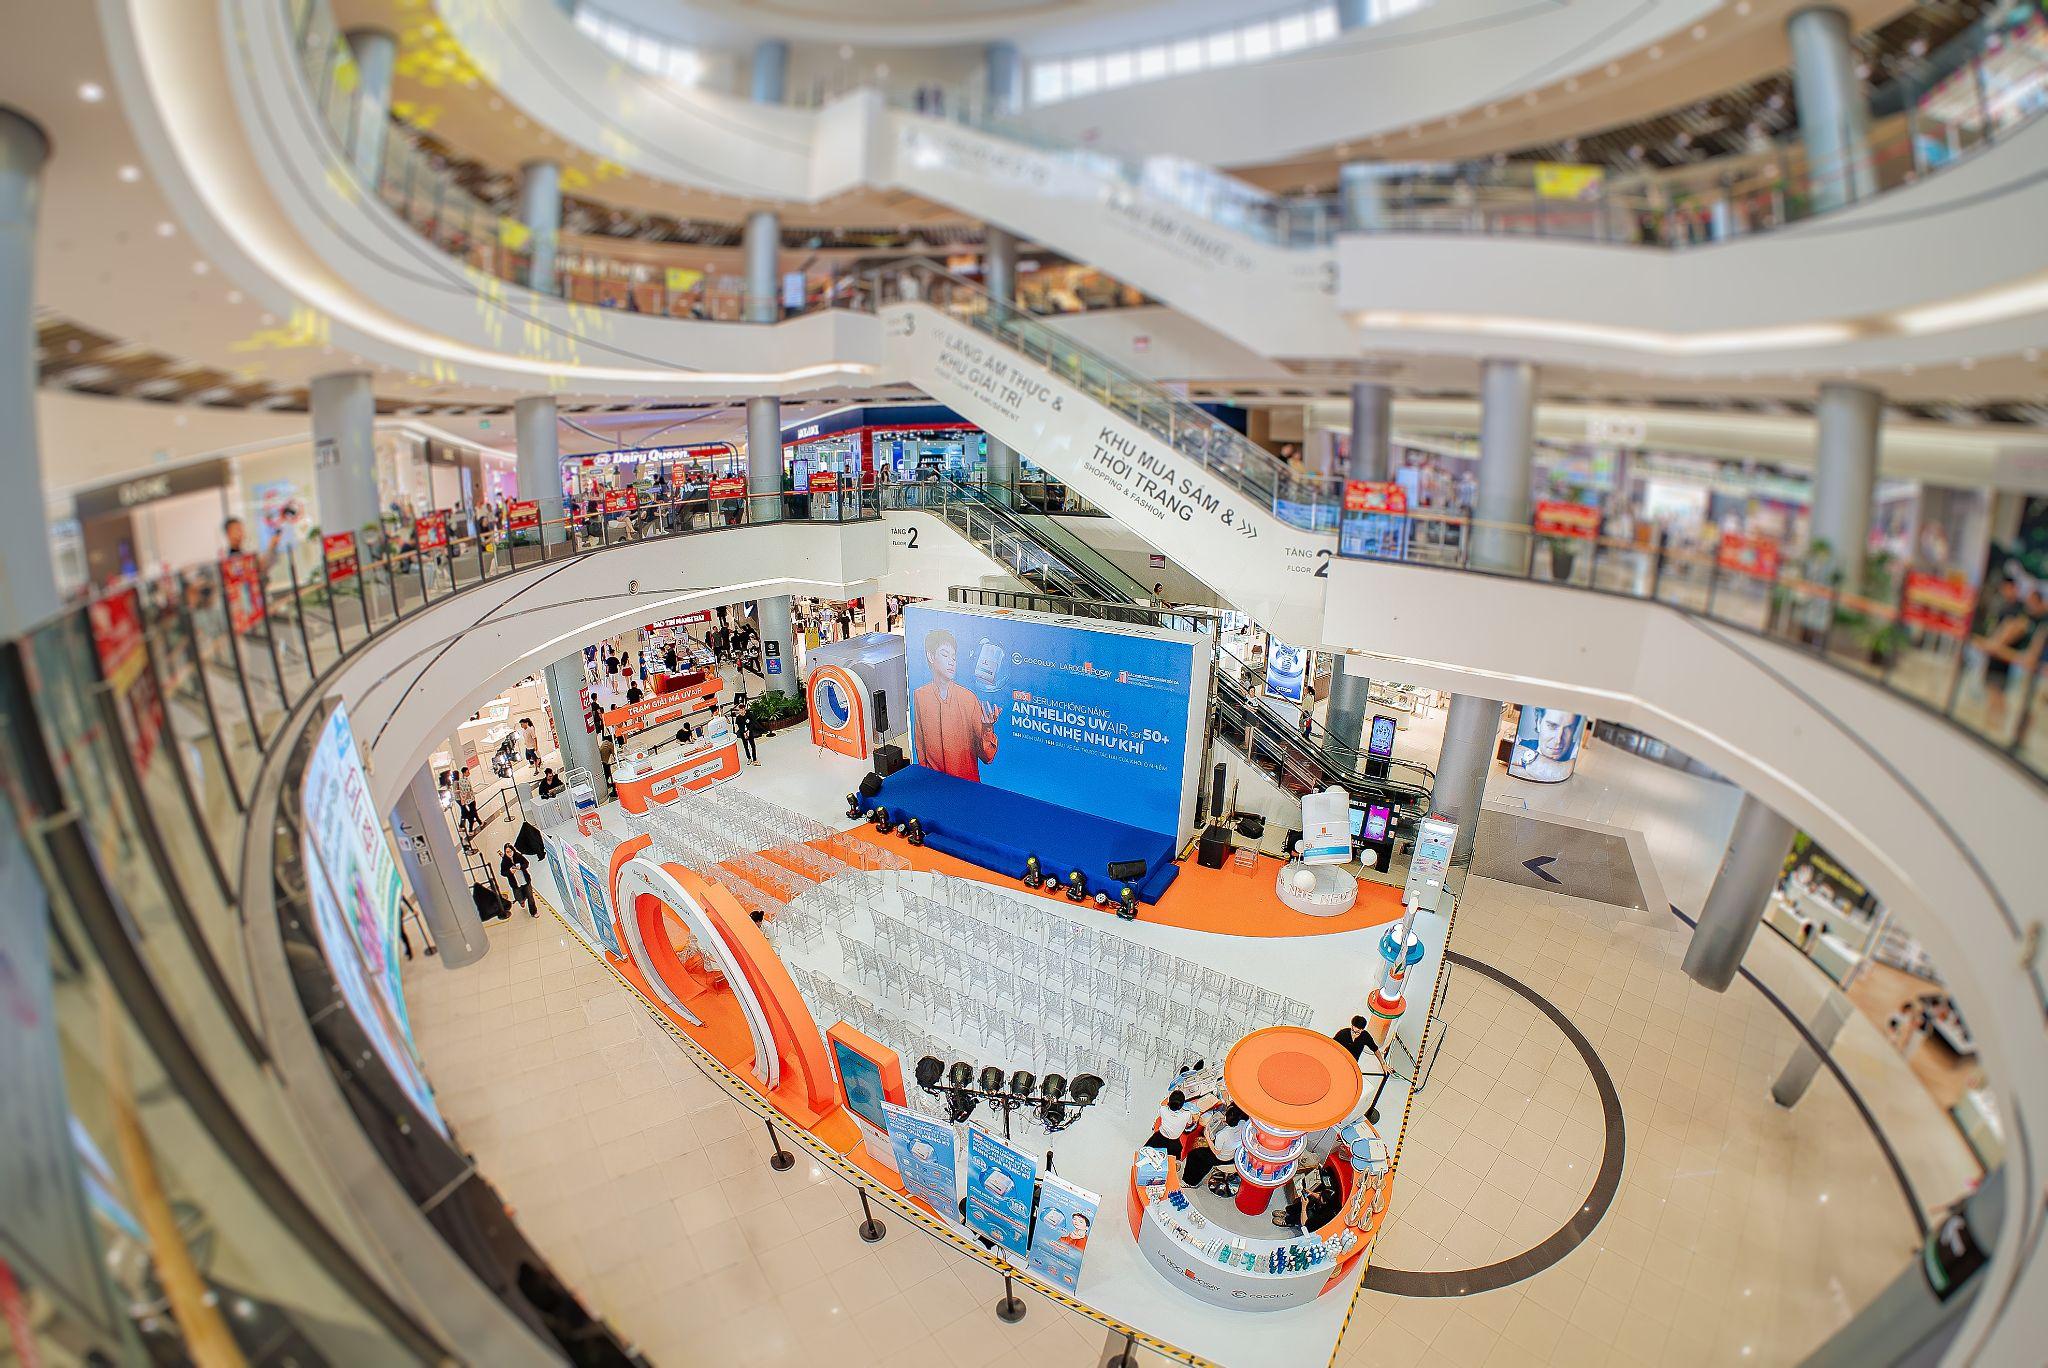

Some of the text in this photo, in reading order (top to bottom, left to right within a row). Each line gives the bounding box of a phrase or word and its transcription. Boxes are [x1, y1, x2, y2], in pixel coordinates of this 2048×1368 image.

[903, 312, 916, 337] 3
[938, 352, 969, 375] KHU
[999, 385, 1026, 409] TRÍ
[944, 336, 985, 365] LÀNG
[1009, 368, 1052, 404] THỰC
[1051, 396, 1063, 412] &
[612, 452, 647, 464] Dairy
[1083, 461, 1166, 520] SHOPPING & FASHION
[1092, 445, 1195, 522] THỜI TRANG
[1098, 426, 1235, 527] KHU MUA SẮM &
[907, 526, 919, 549] 2
[1284, 547, 1333, 578] TẦNG 2
[1286, 565, 1312, 574] FLOOR
[627, 703, 651, 716] TRẠM
[651, 697, 667, 708] GIẢI
[681, 687, 703, 699] UVAIR
[1032, 696, 1059, 708] SERUM
[1011, 713, 1145, 755] MỎNG NHẸ NHƯ KHÍ
[1012, 701, 1086, 727] ANTHELIOS
[1088, 716, 1129, 736] UVAIR
[1142, 728, 1170, 745] 50+
